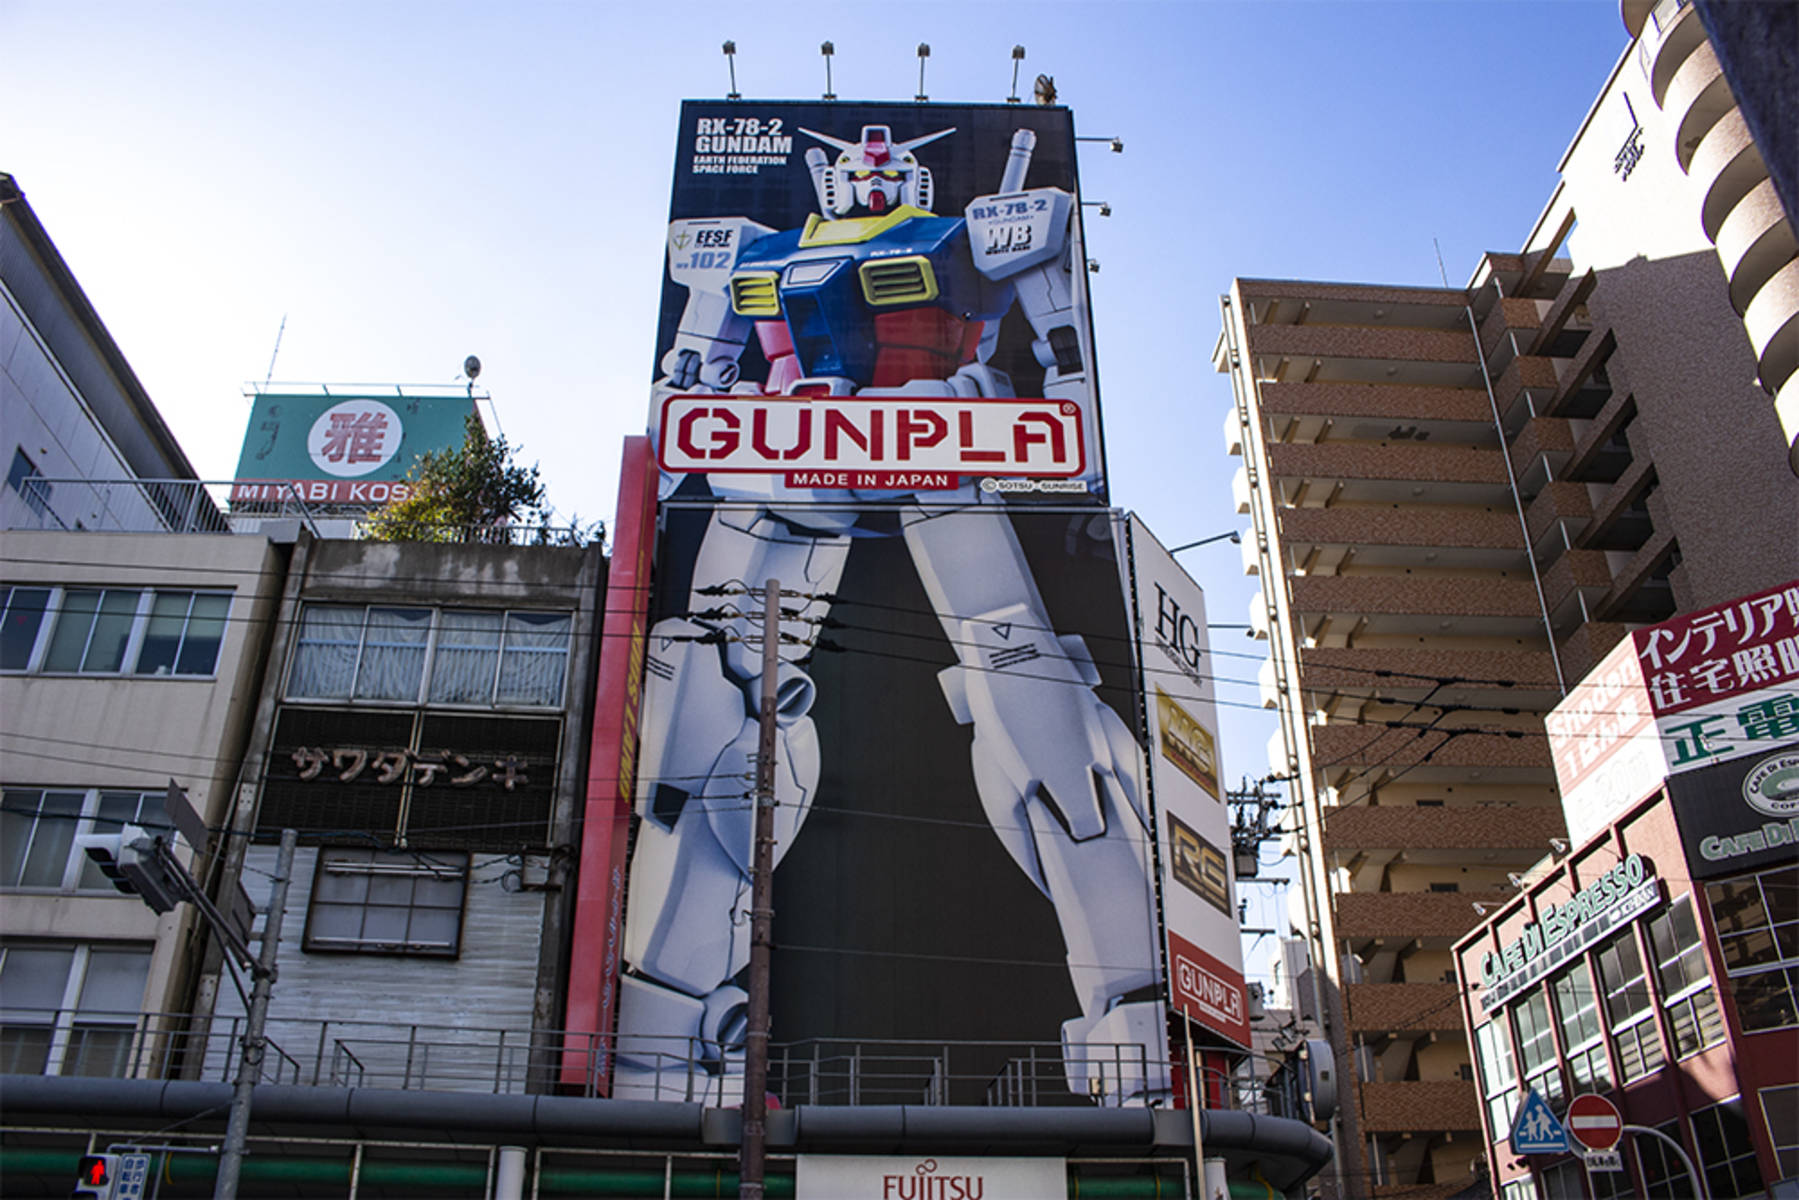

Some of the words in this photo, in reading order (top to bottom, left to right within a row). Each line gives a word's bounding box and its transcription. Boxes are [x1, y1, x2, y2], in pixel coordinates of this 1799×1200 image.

[697, 118, 783, 136] RX-78-2
[695, 135, 793, 154] GUNDAM
[692, 164, 725, 174] SPACE
[726, 164, 759, 174] FORCE
[693, 154, 726, 165] EARTH
[727, 154, 788, 165] FEDERATION
[972, 199, 1048, 220] RX-78-2
[696, 229, 734, 243] EFSF
[986, 224, 1032, 249] WB
[690, 251, 731, 269] 102
[321, 412, 389, 464] 雅
[677, 408, 1067, 464] GUNPLA
[793, 473, 849, 486] MADE
[857, 474, 877, 486] IN
[884, 474, 949, 487] JAPAN
[237, 484, 338, 500] MIYABI
[349, 483, 410, 501] KOS
[1153, 581, 1202, 672] HG
[1700, 829, 1767, 861] CAFE
[1480, 936, 1526, 987] CAFE
[1521, 921, 1545, 962] DI
[1541, 852, 1644, 947] ESPRESSO
[1180, 962, 1241, 1020] GUNPLA
[883, 1174, 984, 1200] FUJITSU
